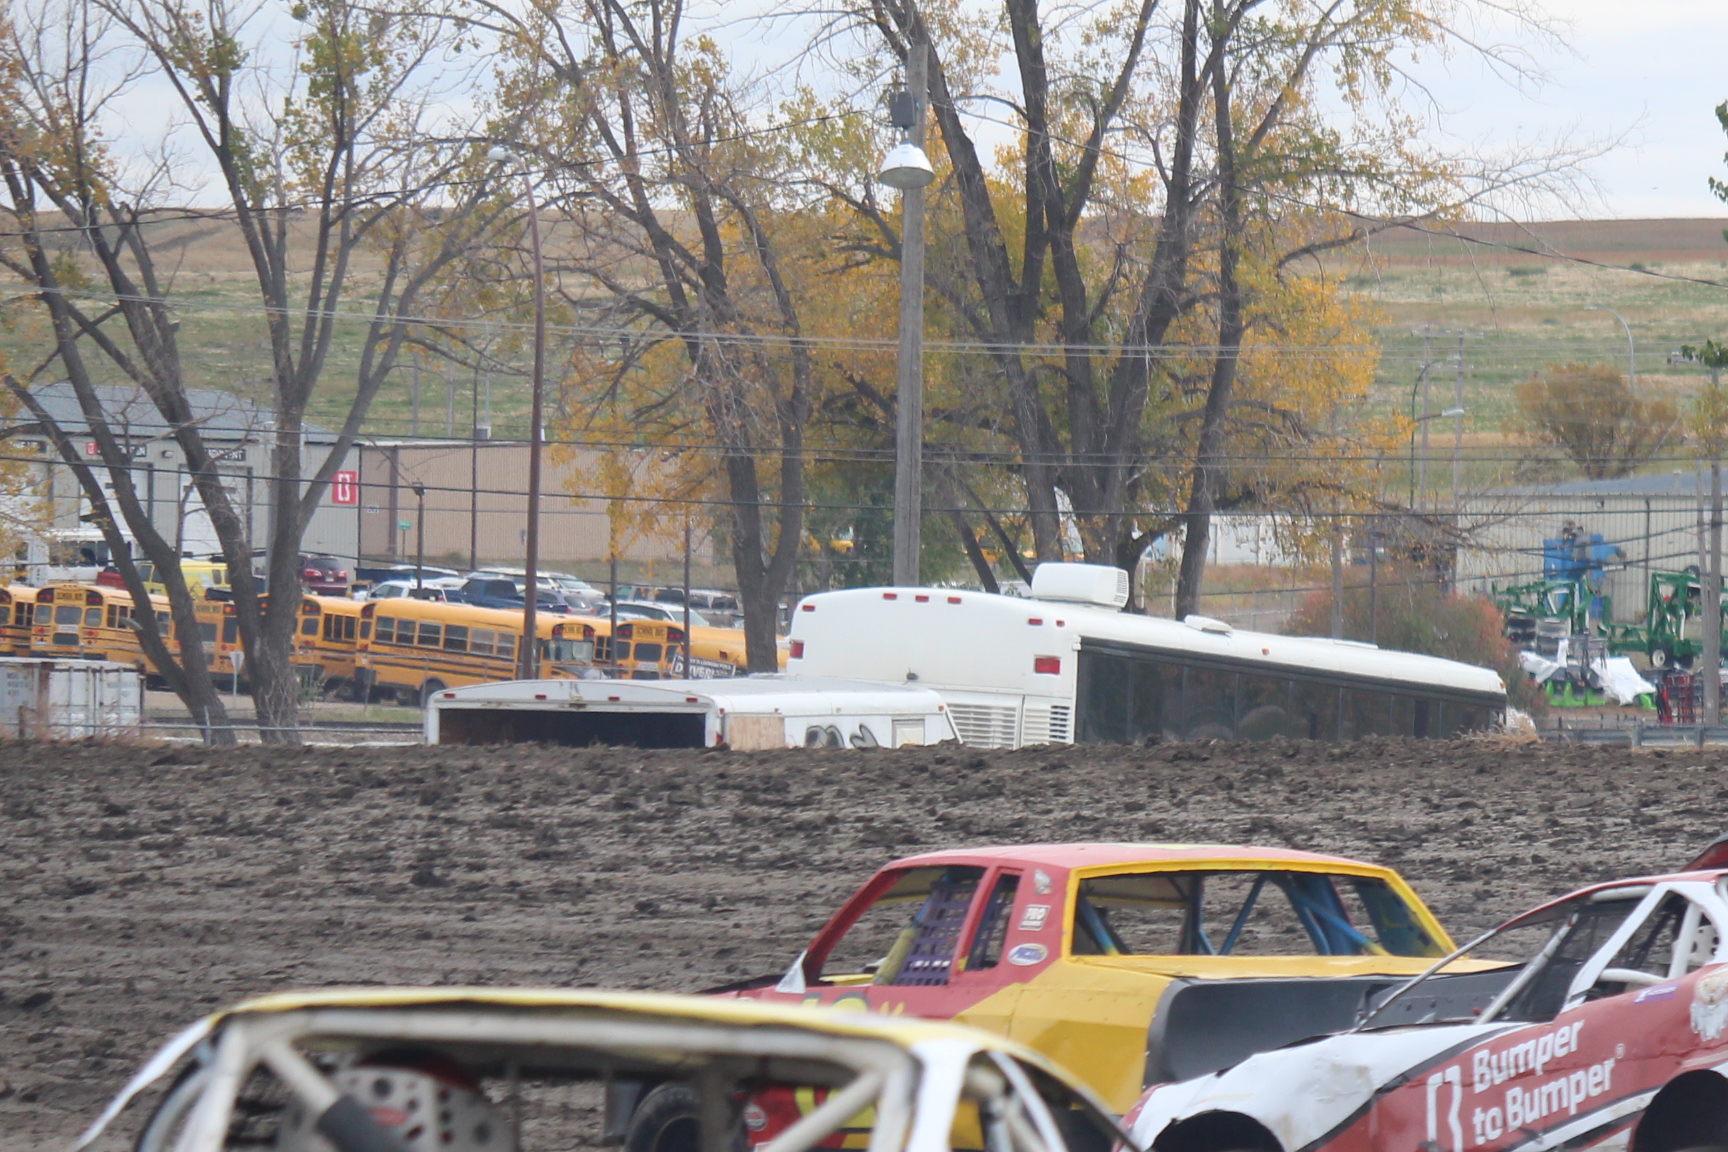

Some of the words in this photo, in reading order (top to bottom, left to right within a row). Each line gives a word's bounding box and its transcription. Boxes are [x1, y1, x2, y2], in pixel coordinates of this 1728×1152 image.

[1473, 1020, 1585, 1093] Bumper
[1473, 1106, 1503, 1145] to
[1506, 1058, 1615, 1132] Bumper
